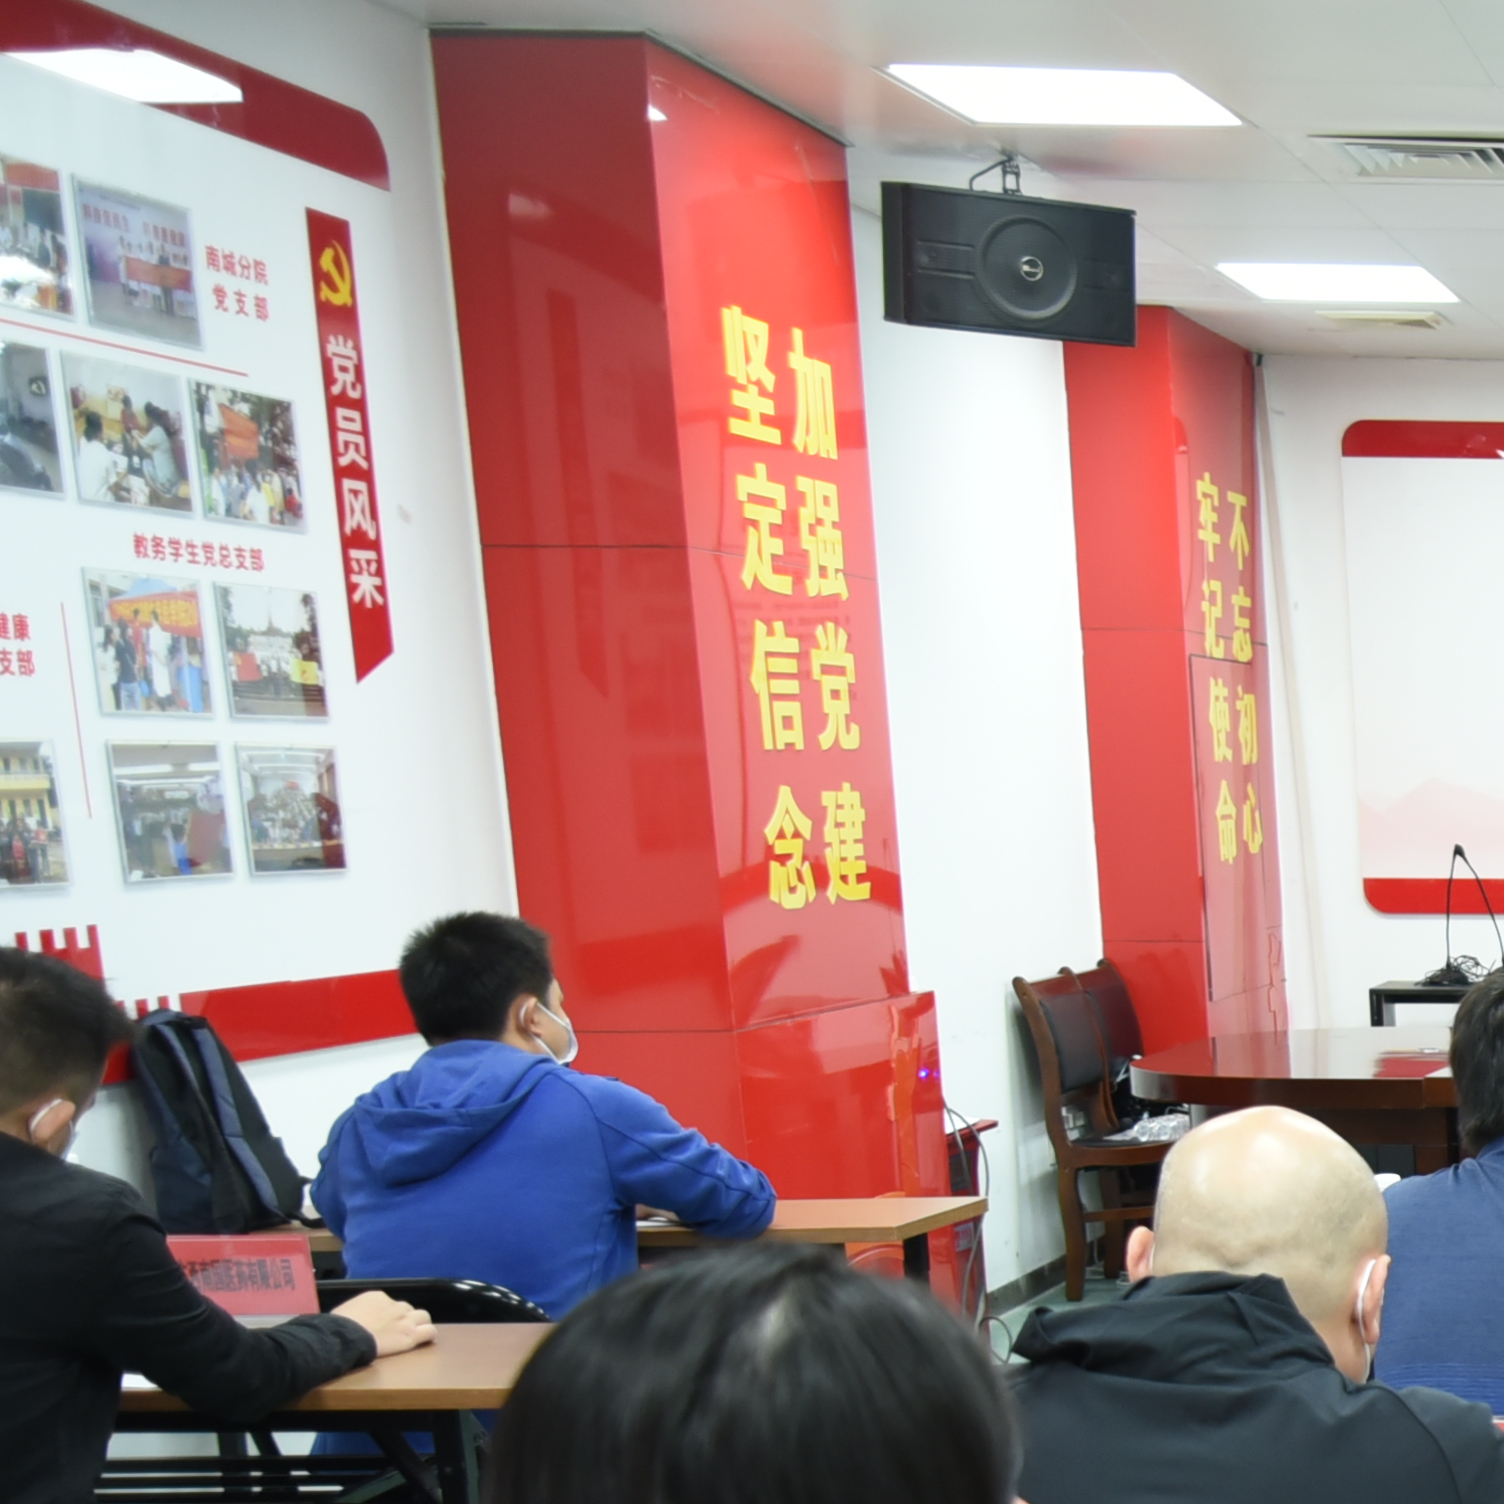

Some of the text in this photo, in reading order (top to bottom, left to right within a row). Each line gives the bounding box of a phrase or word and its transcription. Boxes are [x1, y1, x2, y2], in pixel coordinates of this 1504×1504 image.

[205, 245, 270, 285] 南城分院
[212, 283, 271, 322] 党支部
[132, 532, 266, 573] 教务学生党总支部
[326, 333, 386, 609] 党员风采
[721, 305, 816, 910] 坚定信念
[791, 328, 872, 904] 加强党建
[1196, 472, 1240, 866] 牢记使命
[1226, 489, 1264, 856] 不忘初心
